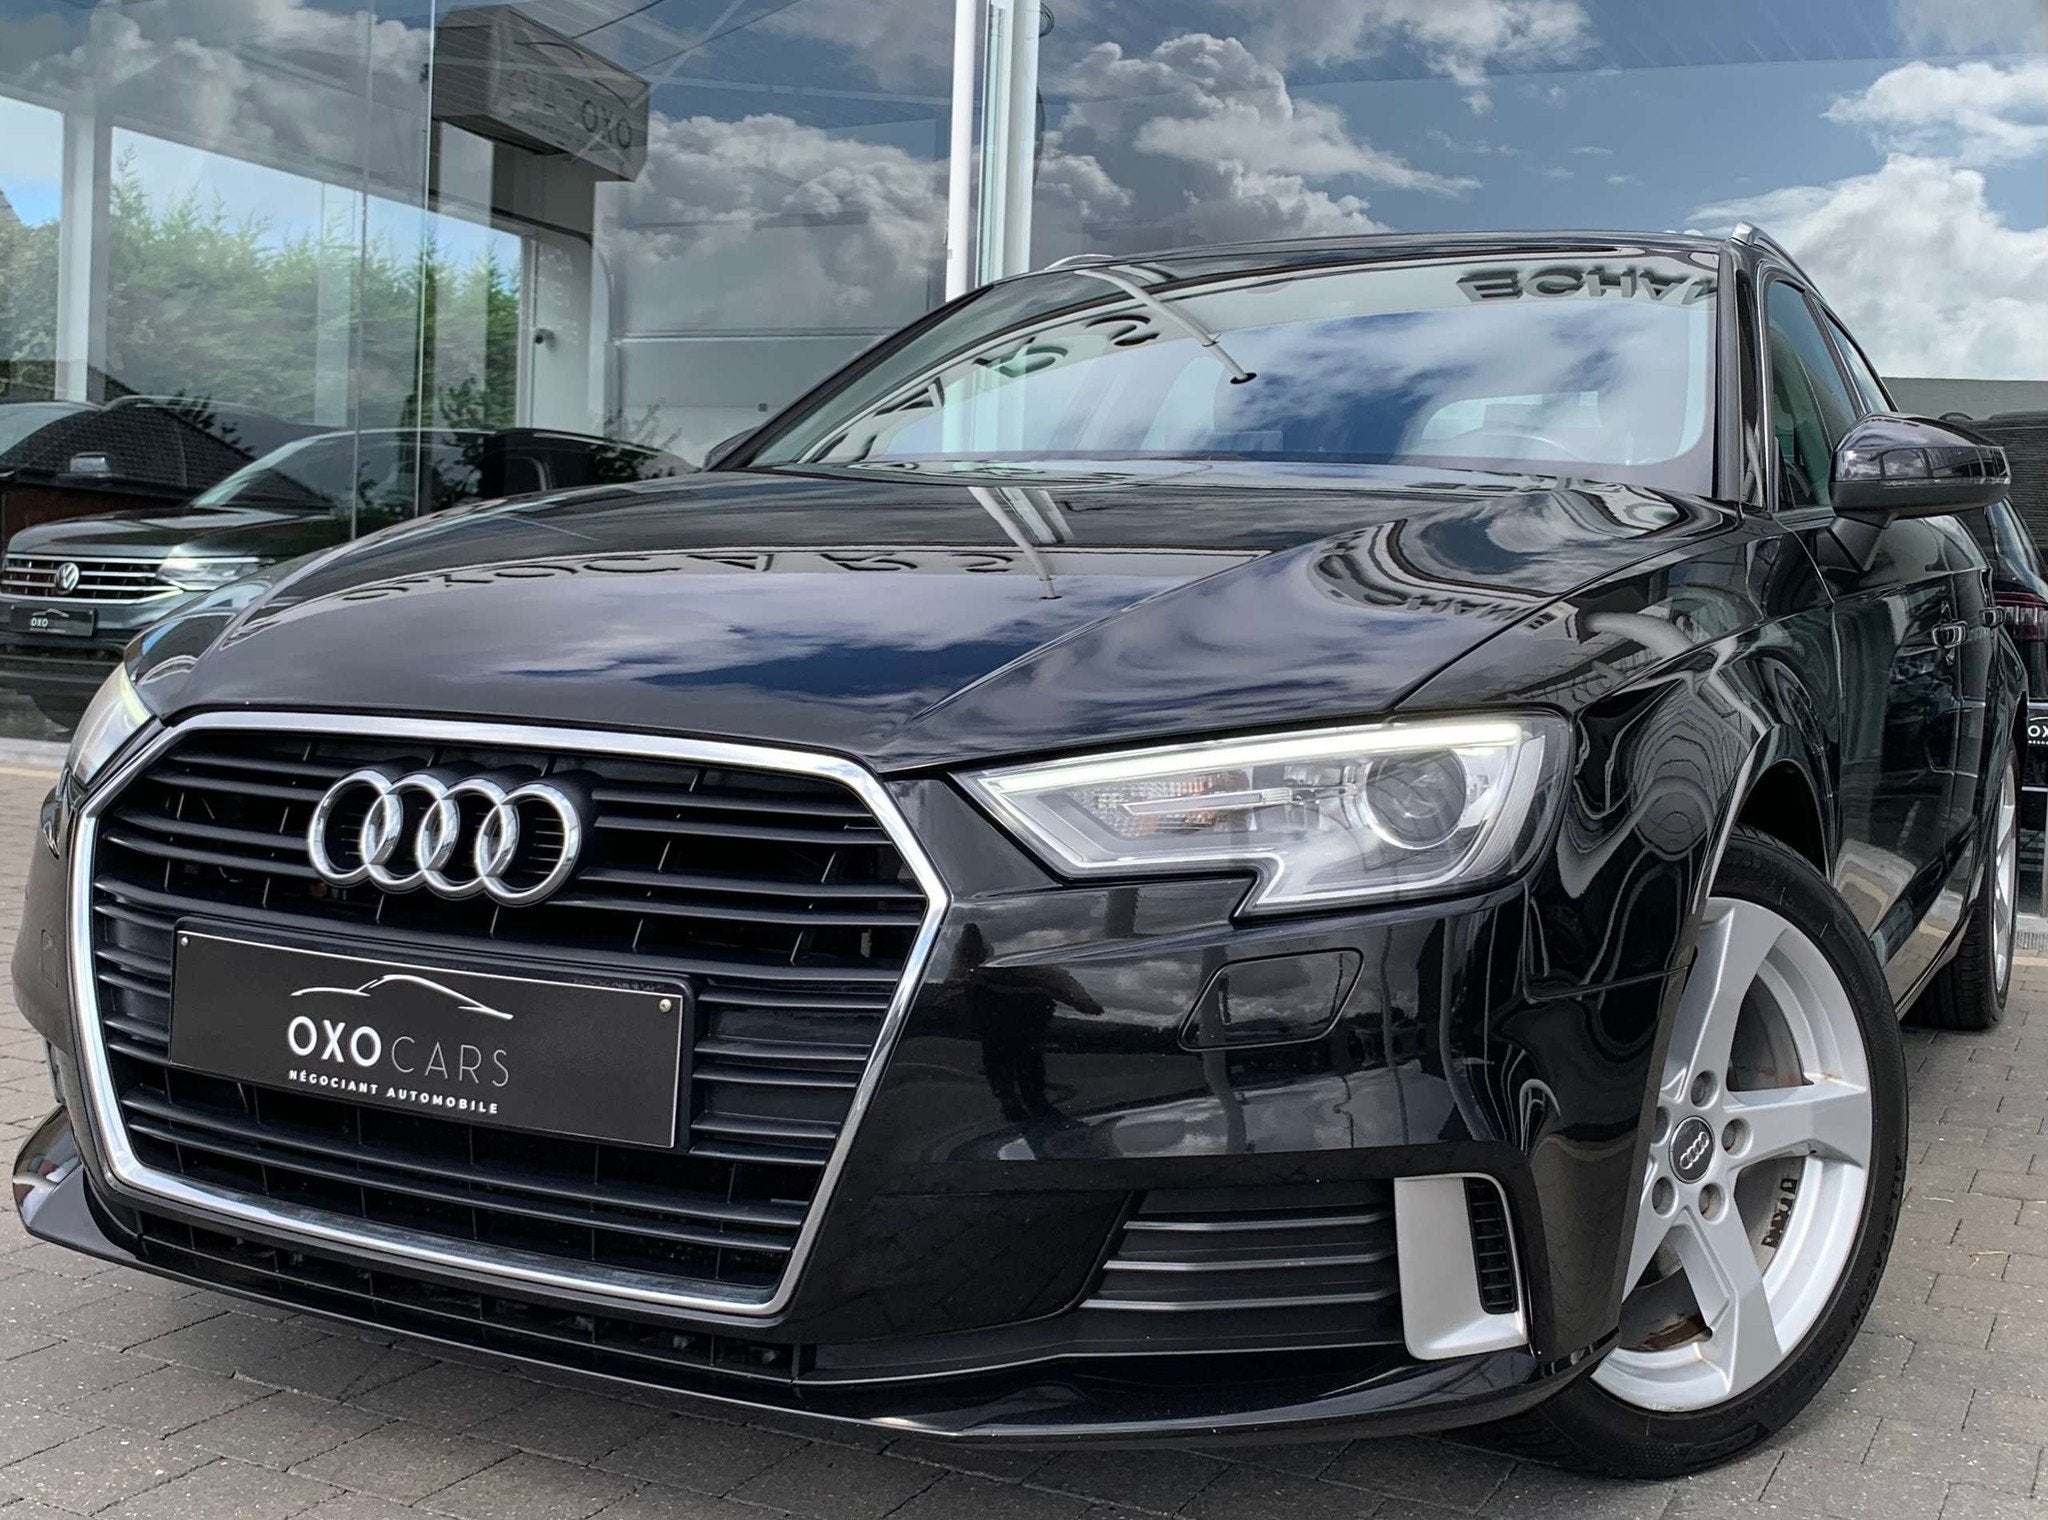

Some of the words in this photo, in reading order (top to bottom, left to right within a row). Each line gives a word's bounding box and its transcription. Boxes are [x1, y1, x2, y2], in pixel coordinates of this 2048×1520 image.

[30, 617, 49, 628] OXO
[287, 1015, 382, 1068] OXO
[390, 1036, 510, 1088] CARS
[287, 1068, 379, 1096] NÉGOCIANT
[386, 1086, 499, 1115] AUTOMOBILE
[1890, 1154, 1903, 1205] ALL
[1849, 1214, 1895, 1330] SEASON
